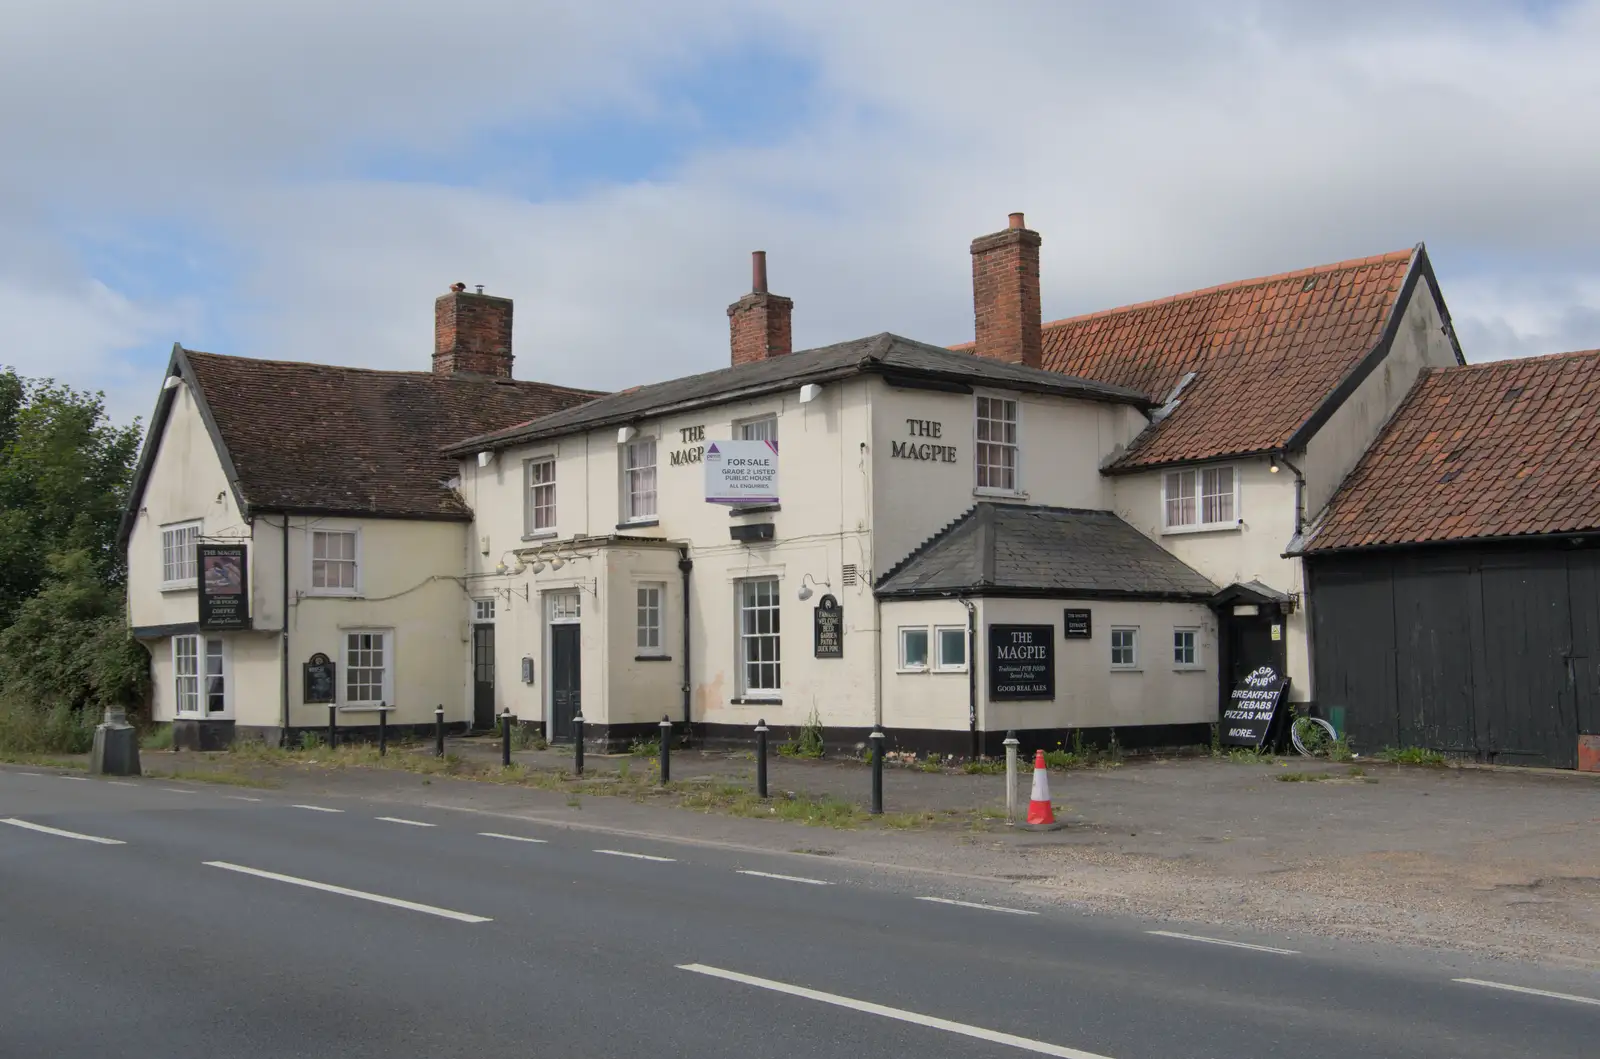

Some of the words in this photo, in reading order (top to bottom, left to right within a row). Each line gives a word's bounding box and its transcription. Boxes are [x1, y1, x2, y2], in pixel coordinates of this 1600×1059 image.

[680, 425, 706, 444] THE
[906, 419, 942, 439] THE
[670, 446, 704, 466] MAGP
[891, 440, 957, 463] MAGPIE
[747, 458, 770, 466] SALE
[1011, 632, 1033, 643] THE
[997, 645, 1046, 660] MAGPIE
[1244, 666, 1277, 684] MAGPIE
[1251, 677, 1269, 687] PUB
[1032, 684, 1047, 692] ALES
[1231, 690, 1280, 699] BREAKFAST
[1237, 701, 1272, 710] KEBABS
[1224, 710, 1254, 720] PIZZAS
[1255, 712, 1273, 720] AND
